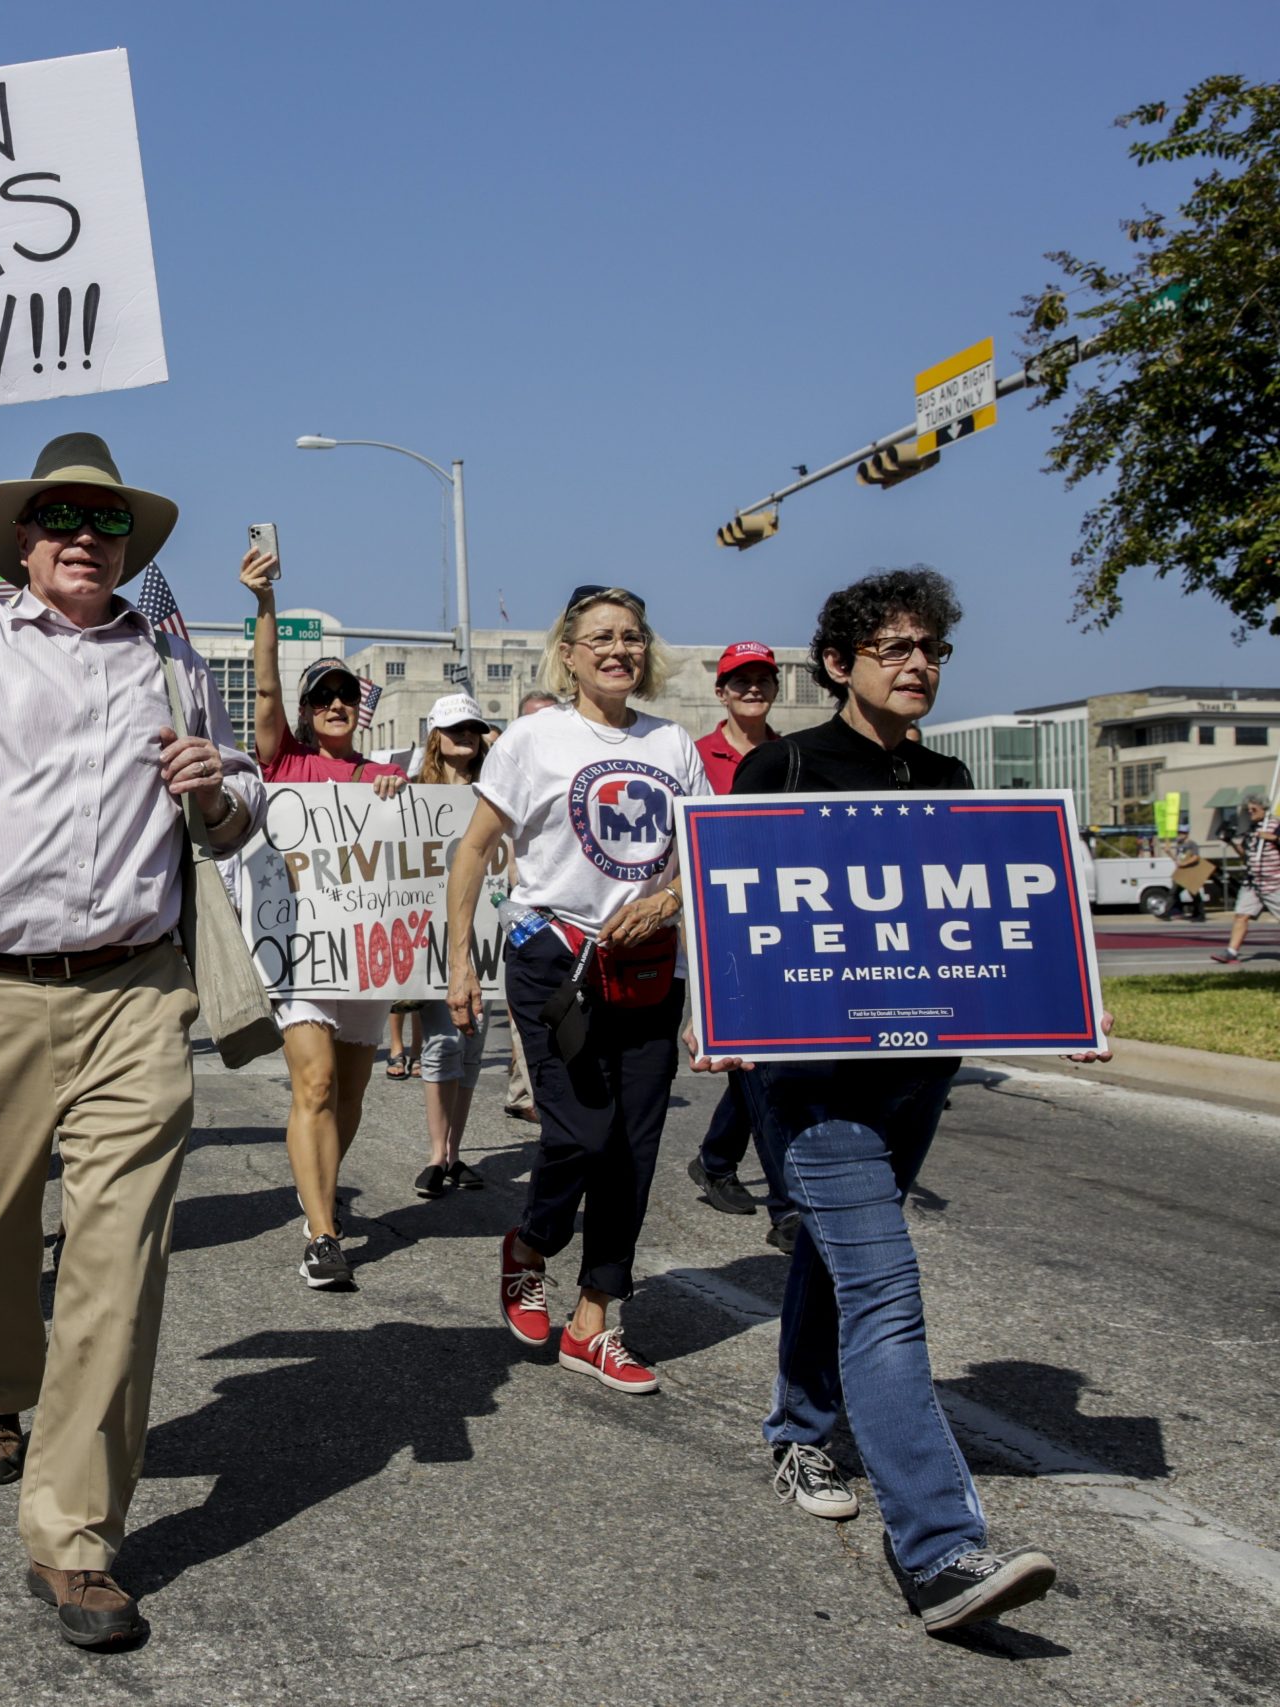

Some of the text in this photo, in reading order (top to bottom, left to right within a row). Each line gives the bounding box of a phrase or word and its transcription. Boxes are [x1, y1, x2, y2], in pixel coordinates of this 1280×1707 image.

[918, 364, 991, 413] BUS AND RIGHT
[926, 387, 983, 427] TURN ONLY
[246, 621, 319, 637] Lca ST
[299, 630, 320, 639] 1000
[572, 761, 648, 803] REPUBLICAN
[263, 784, 456, 875] Only the
[284, 836, 509, 894] PRIVILED
[594, 853, 665, 881] OF TEXAS
[709, 863, 1057, 914] TRUMP
[257, 897, 317, 931] can
[252, 909, 504, 992] OPEN 100% NW
[749, 920, 1034, 955] PENCE
[784, 965, 1008, 983] KEEP AMERICA GREAT!
[878, 1031, 928, 1047] 2020
